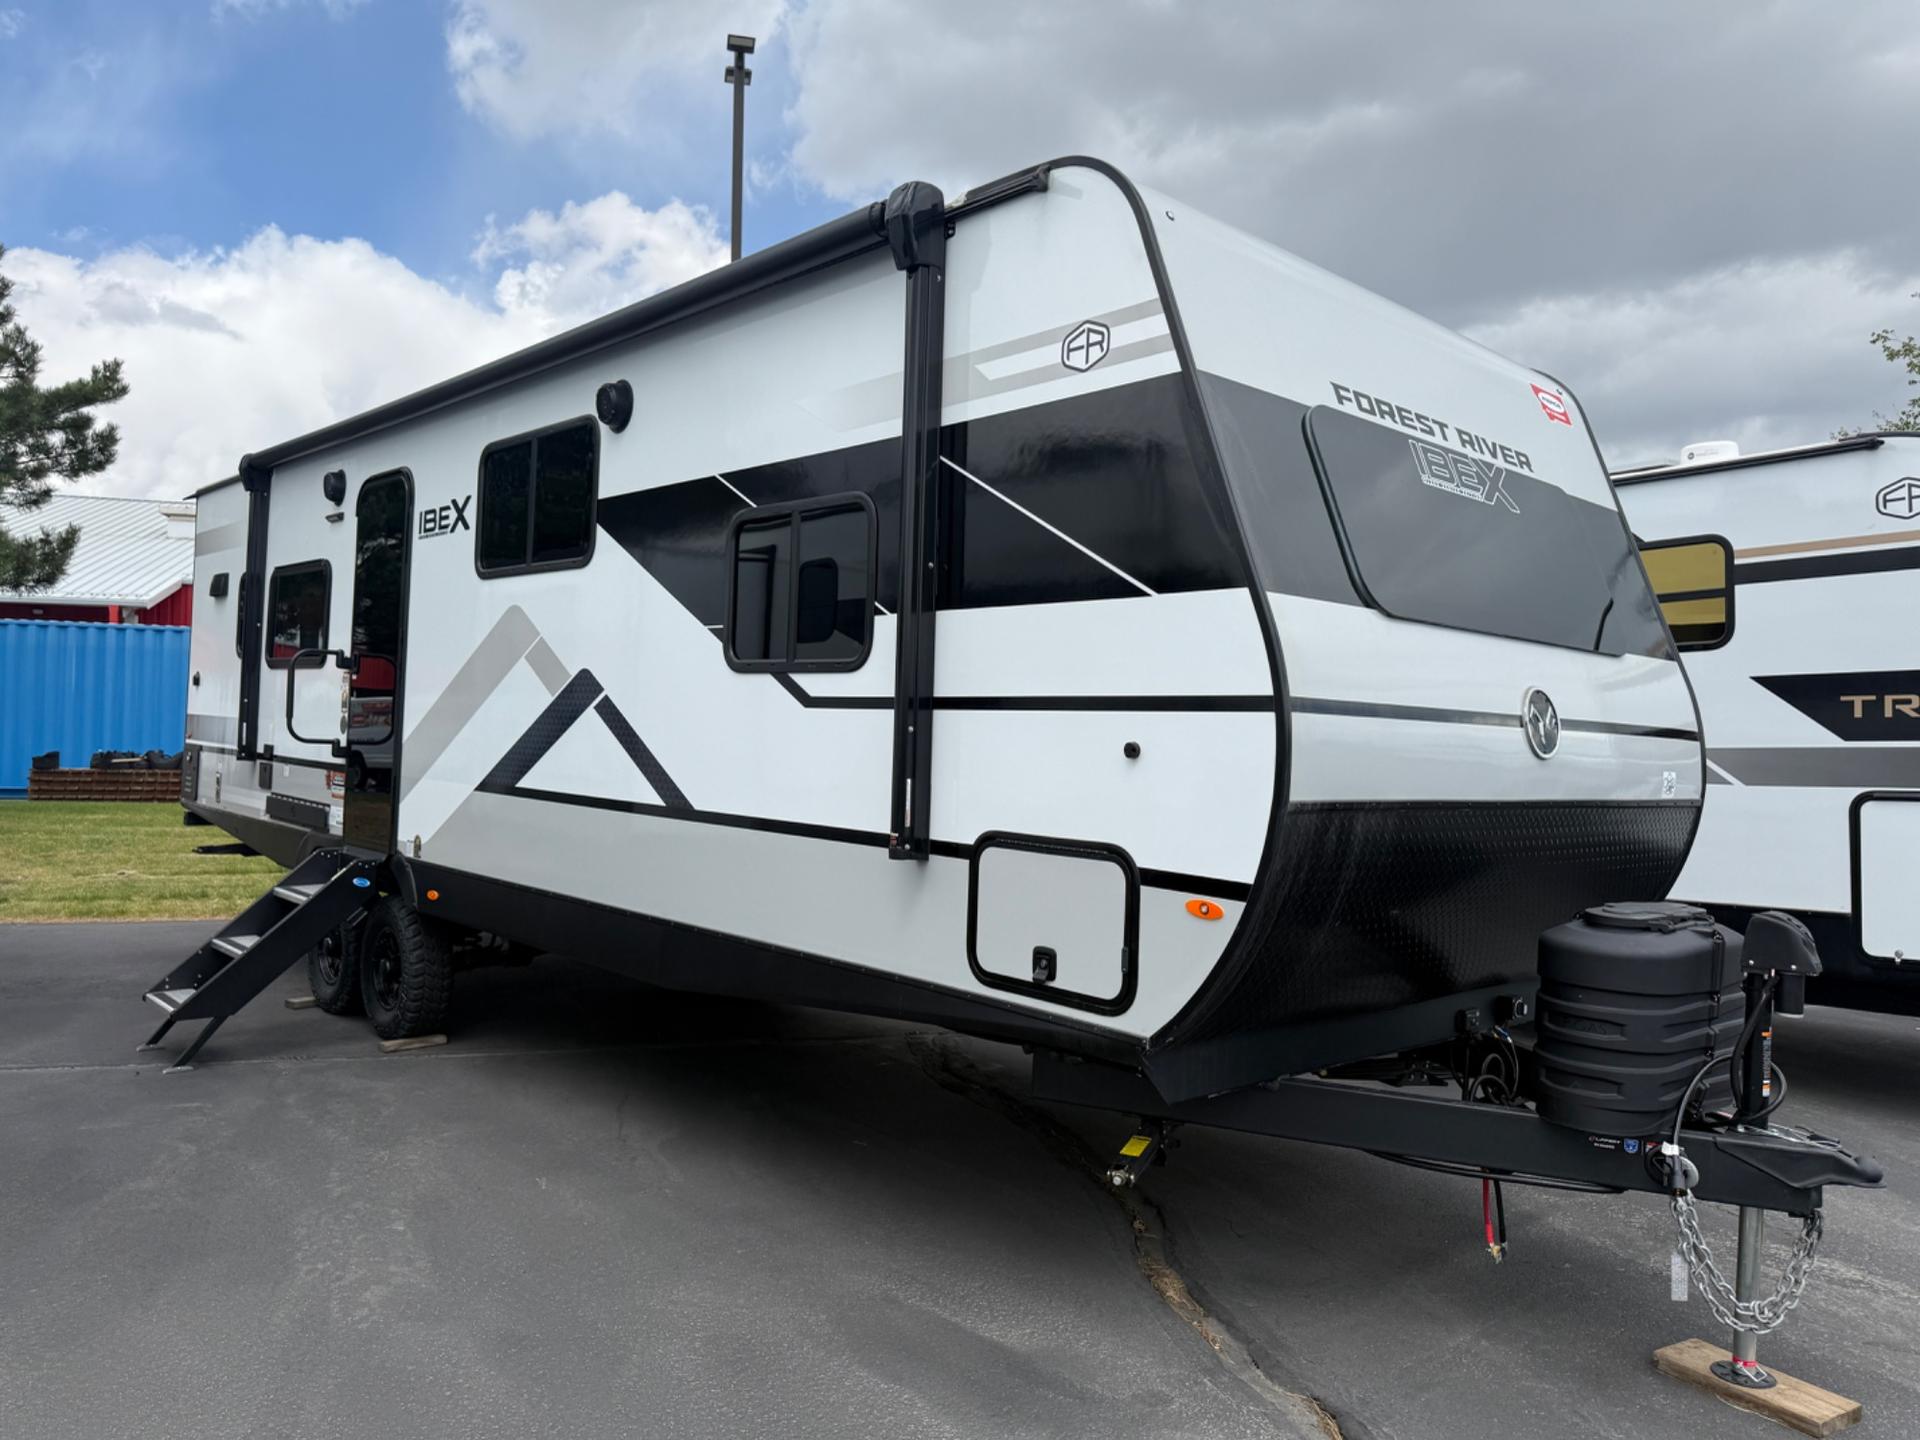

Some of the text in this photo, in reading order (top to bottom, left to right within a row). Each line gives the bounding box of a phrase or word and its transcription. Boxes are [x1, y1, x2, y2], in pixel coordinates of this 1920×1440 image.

[1329, 381, 1535, 473] FOREST RIVER
[1408, 439, 1520, 514] IBEX
[418, 494, 472, 535] IBEX
[1840, 694, 1920, 718] TR
